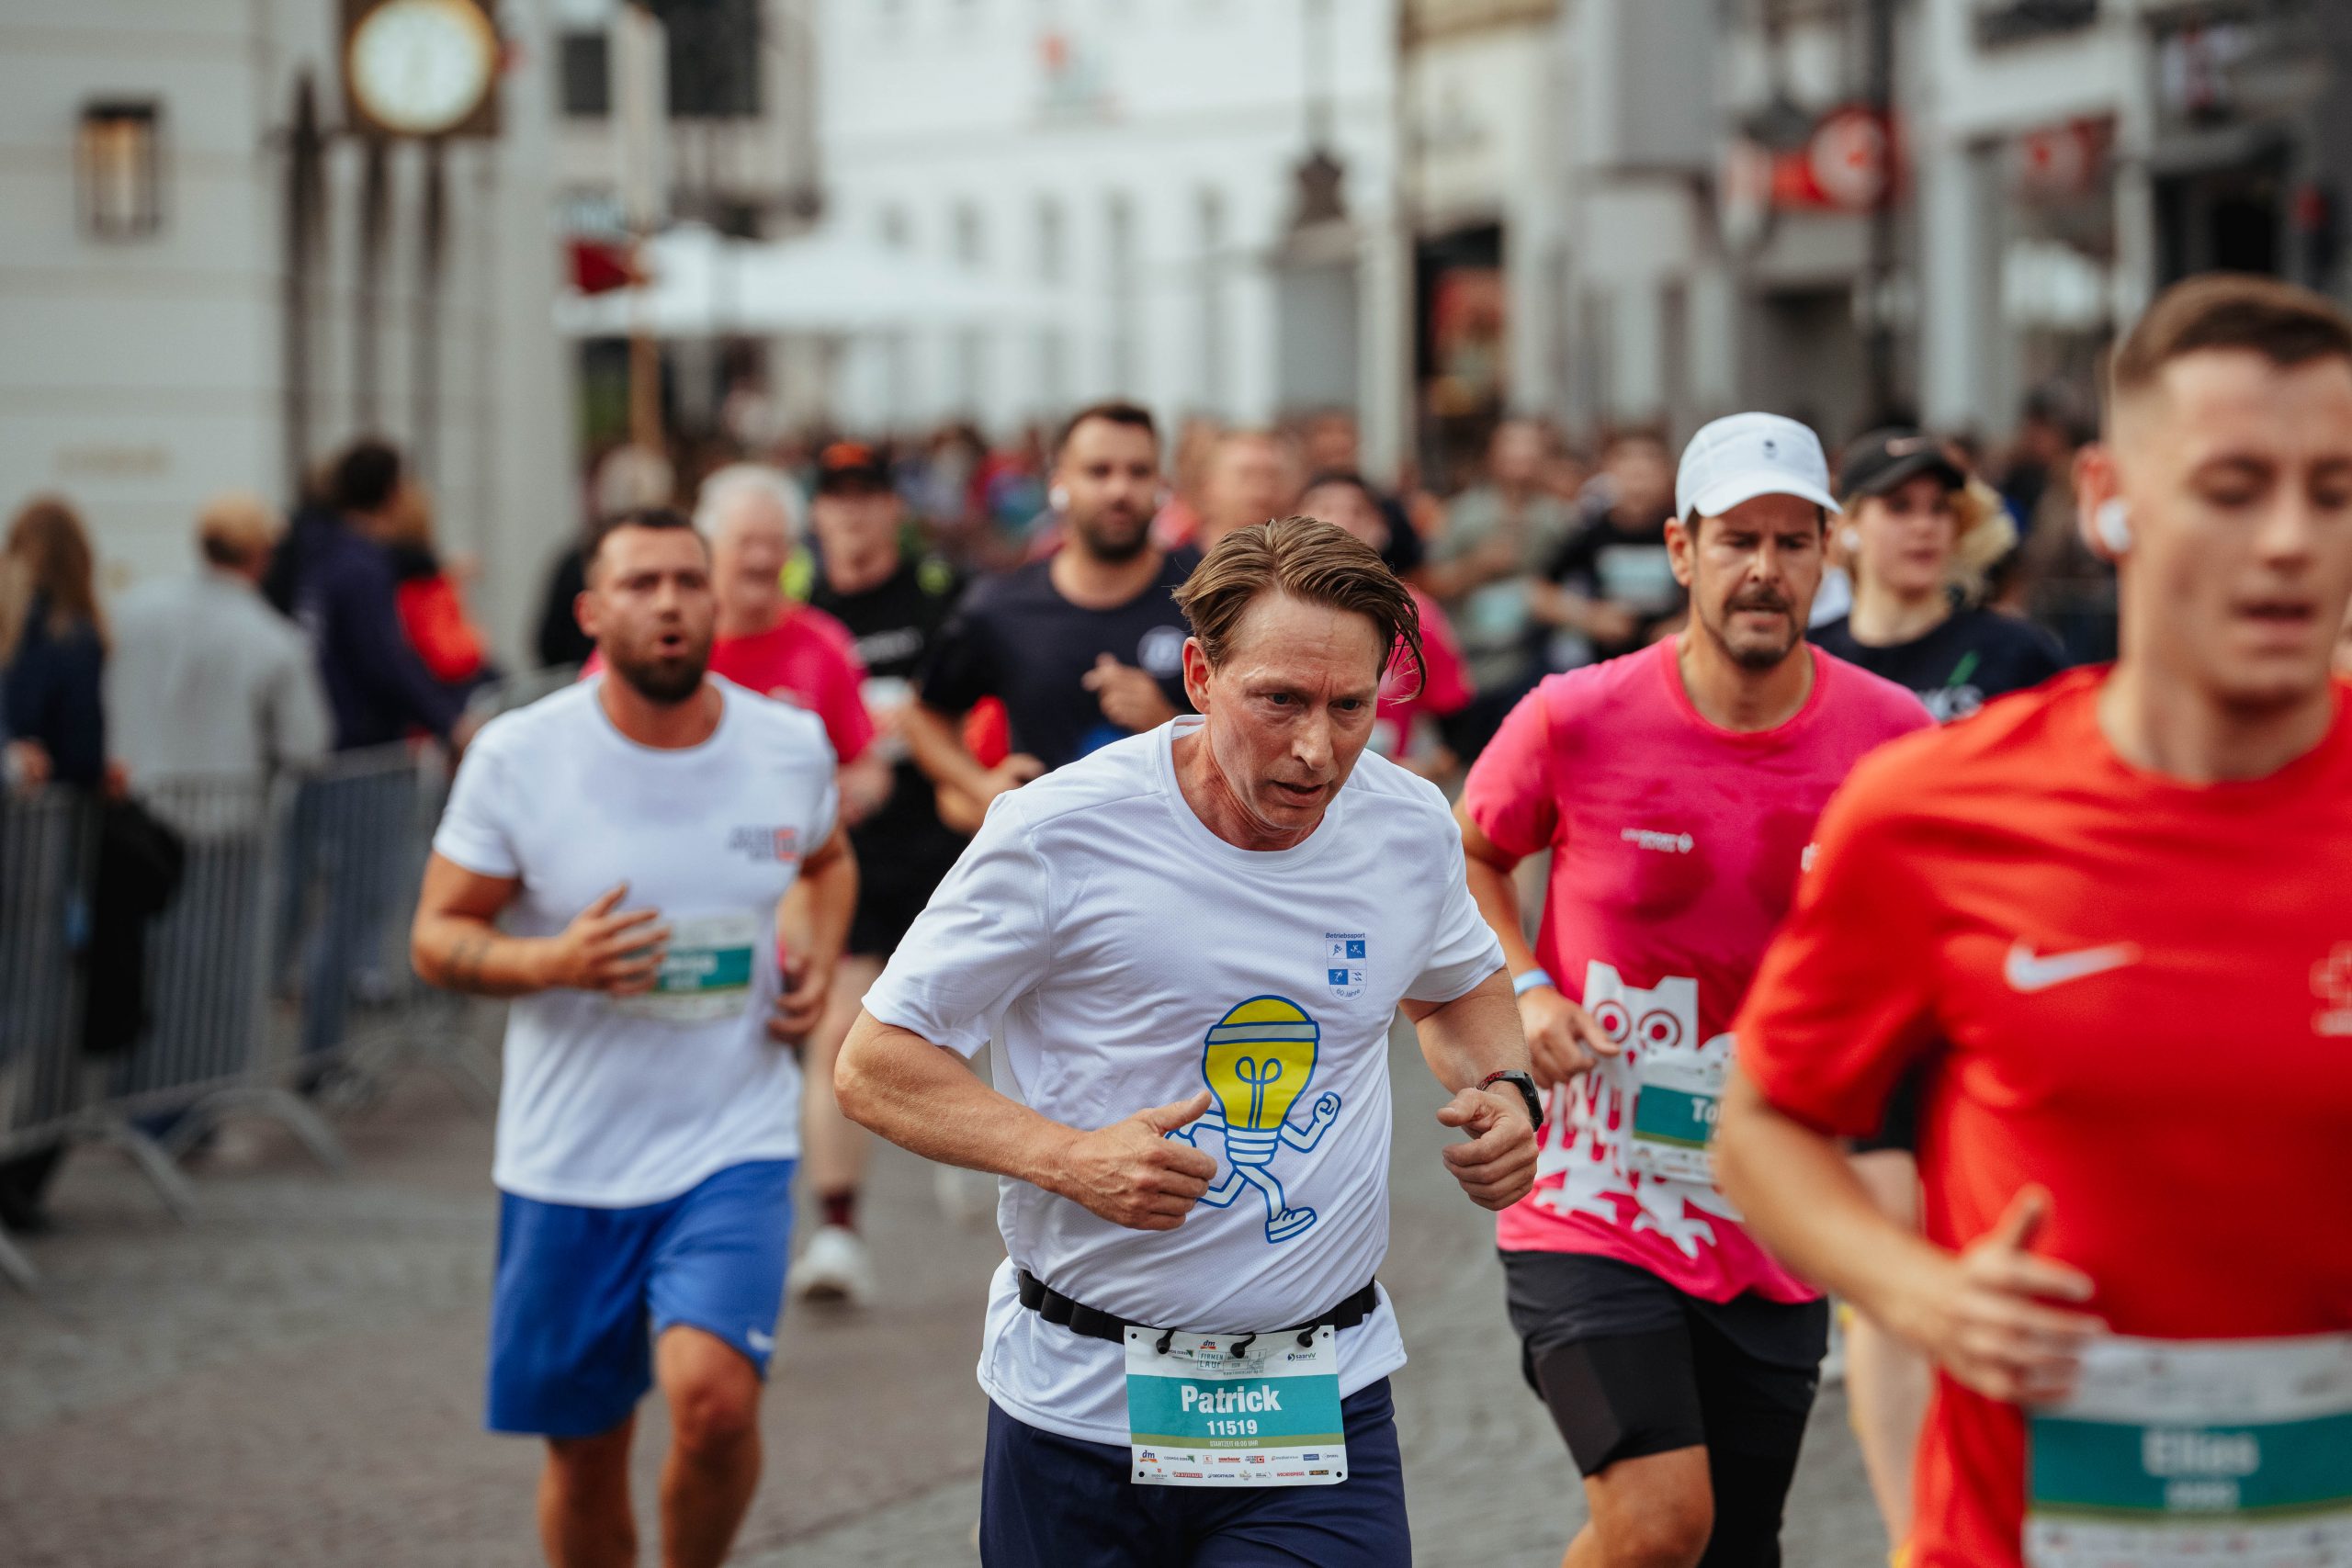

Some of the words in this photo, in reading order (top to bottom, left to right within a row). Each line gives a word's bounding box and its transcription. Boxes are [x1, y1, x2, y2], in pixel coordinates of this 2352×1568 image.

[1199, 1360, 1221, 1369] LAUF
[1181, 1385, 1282, 1413] Patrick
[1206, 1419, 1258, 1436] 11519
[1142, 1450, 1156, 1459] dm
